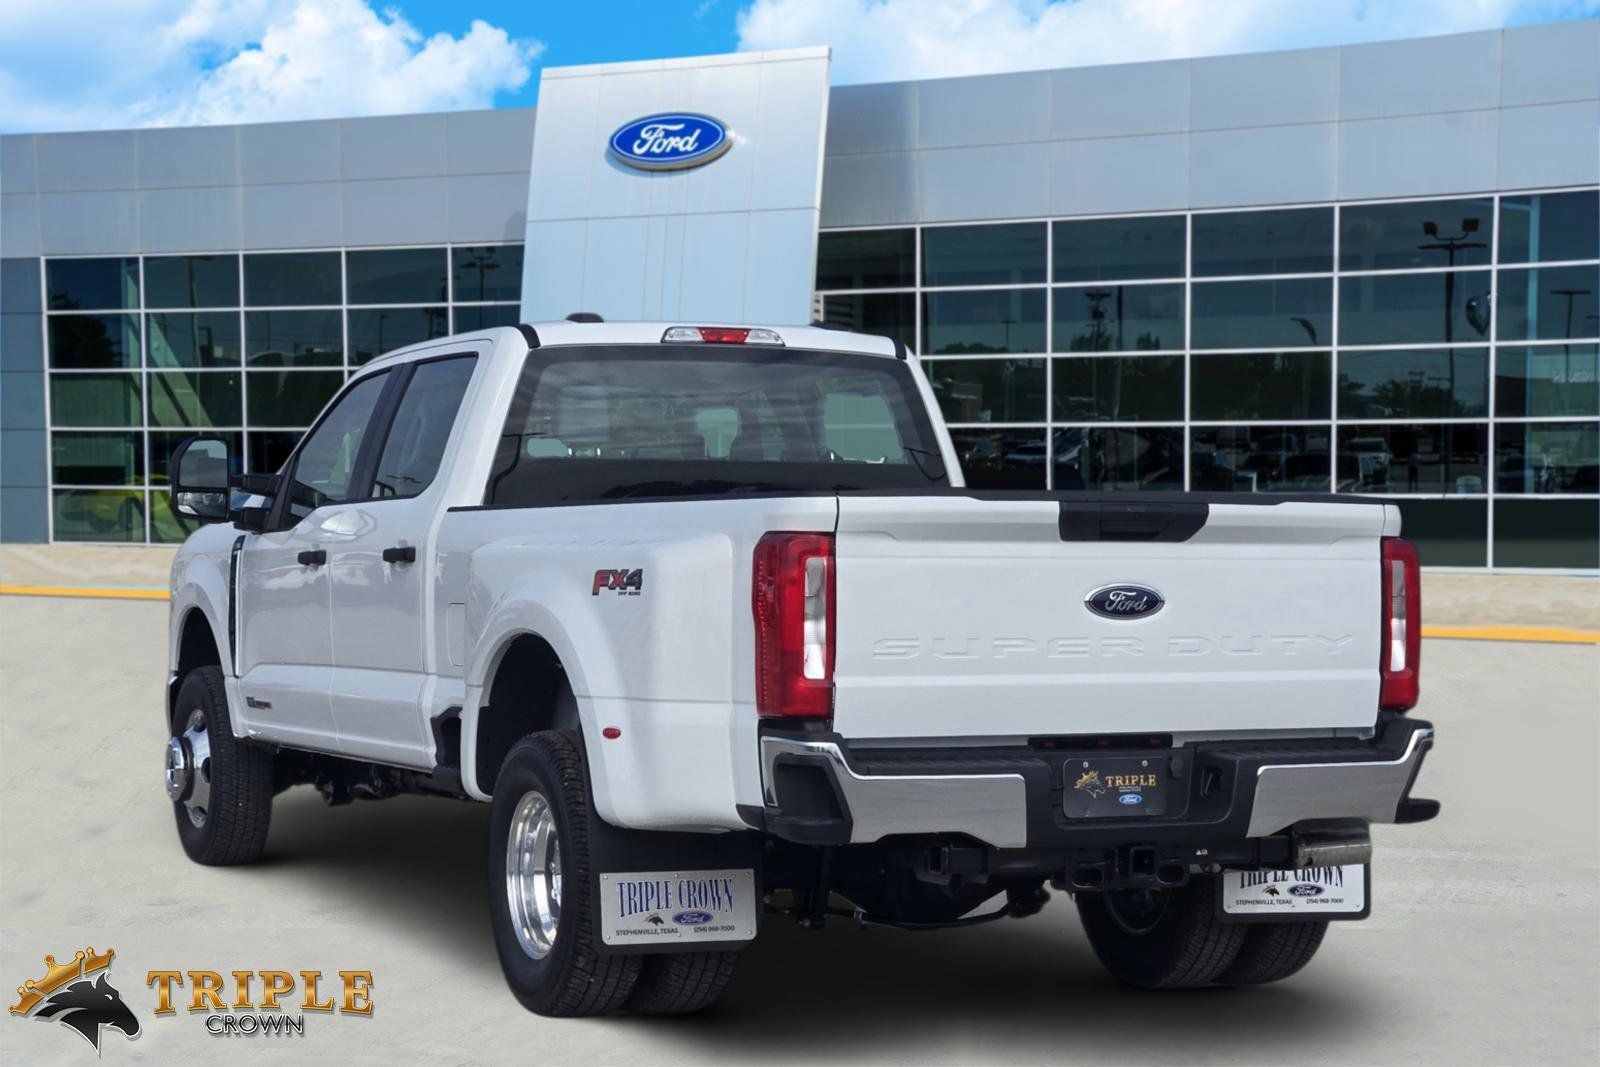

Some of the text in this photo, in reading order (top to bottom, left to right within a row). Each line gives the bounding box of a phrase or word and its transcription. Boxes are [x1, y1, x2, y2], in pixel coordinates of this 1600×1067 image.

[632, 123, 701, 155] Ford
[592, 568, 643, 596] FX4
[1105, 590, 1148, 611] Ford
[872, 634, 1353, 660] SUPER DUTY
[1105, 774, 1157, 788] TRIPLE
[617, 878, 733, 918] TRIPLE CROWN
[1295, 886, 1318, 896] Ford
[680, 913, 706, 924] Ford
